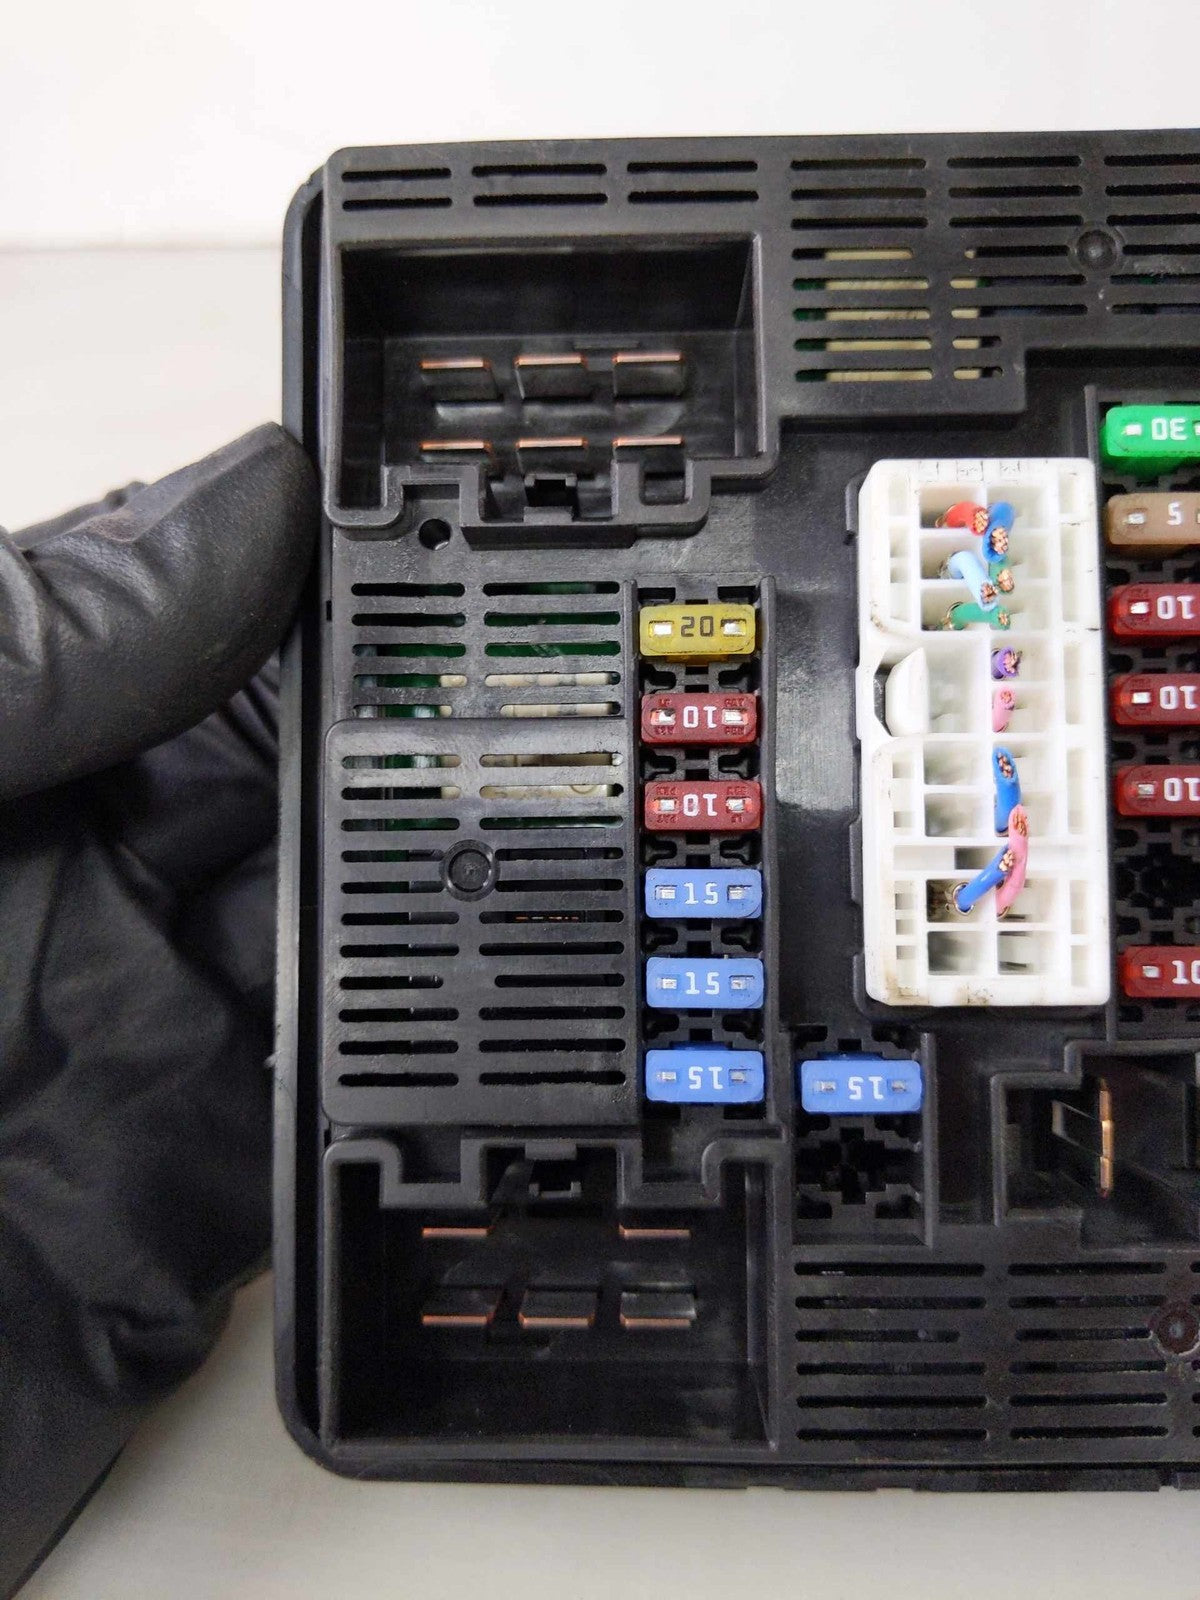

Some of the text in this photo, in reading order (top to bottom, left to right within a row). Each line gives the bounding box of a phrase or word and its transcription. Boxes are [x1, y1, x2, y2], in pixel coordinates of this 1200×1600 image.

[1151, 417, 1188, 441] 30
[1167, 501, 1183, 526] 5
[1157, 595, 1196, 620] 10
[680, 615, 714, 638] 20
[1159, 685, 1198, 710] 10
[683, 705, 718, 728] 10
[1163, 777, 1200, 802] 10
[682, 793, 718, 817] 10
[683, 882, 720, 905] 15
[685, 971, 720, 995] 15
[688, 1066, 723, 1090] 15
[847, 1075, 884, 1100] 15
